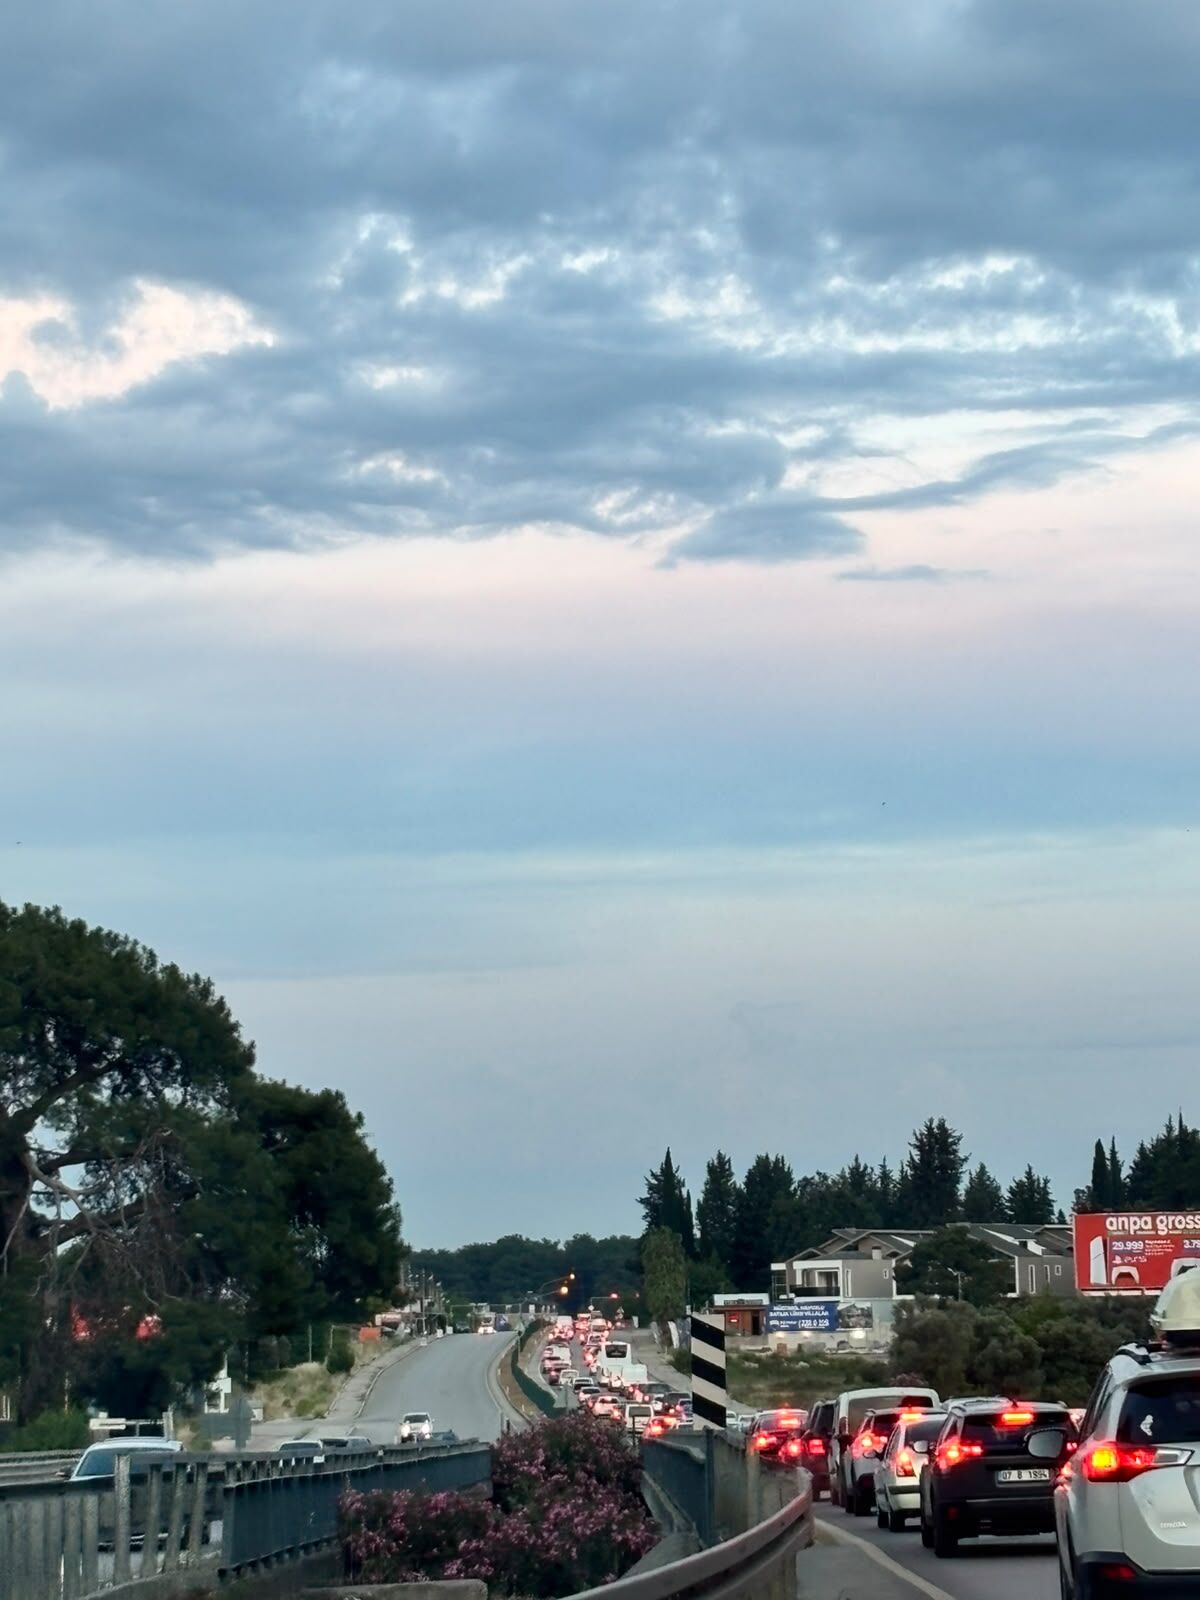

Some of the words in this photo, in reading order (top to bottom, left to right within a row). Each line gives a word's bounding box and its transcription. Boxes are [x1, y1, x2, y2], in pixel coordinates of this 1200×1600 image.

[1106, 1216, 1152, 1235] anpa
[1156, 1215, 1200, 1235] gross
[1112, 1241, 1143, 1250] 29.999
